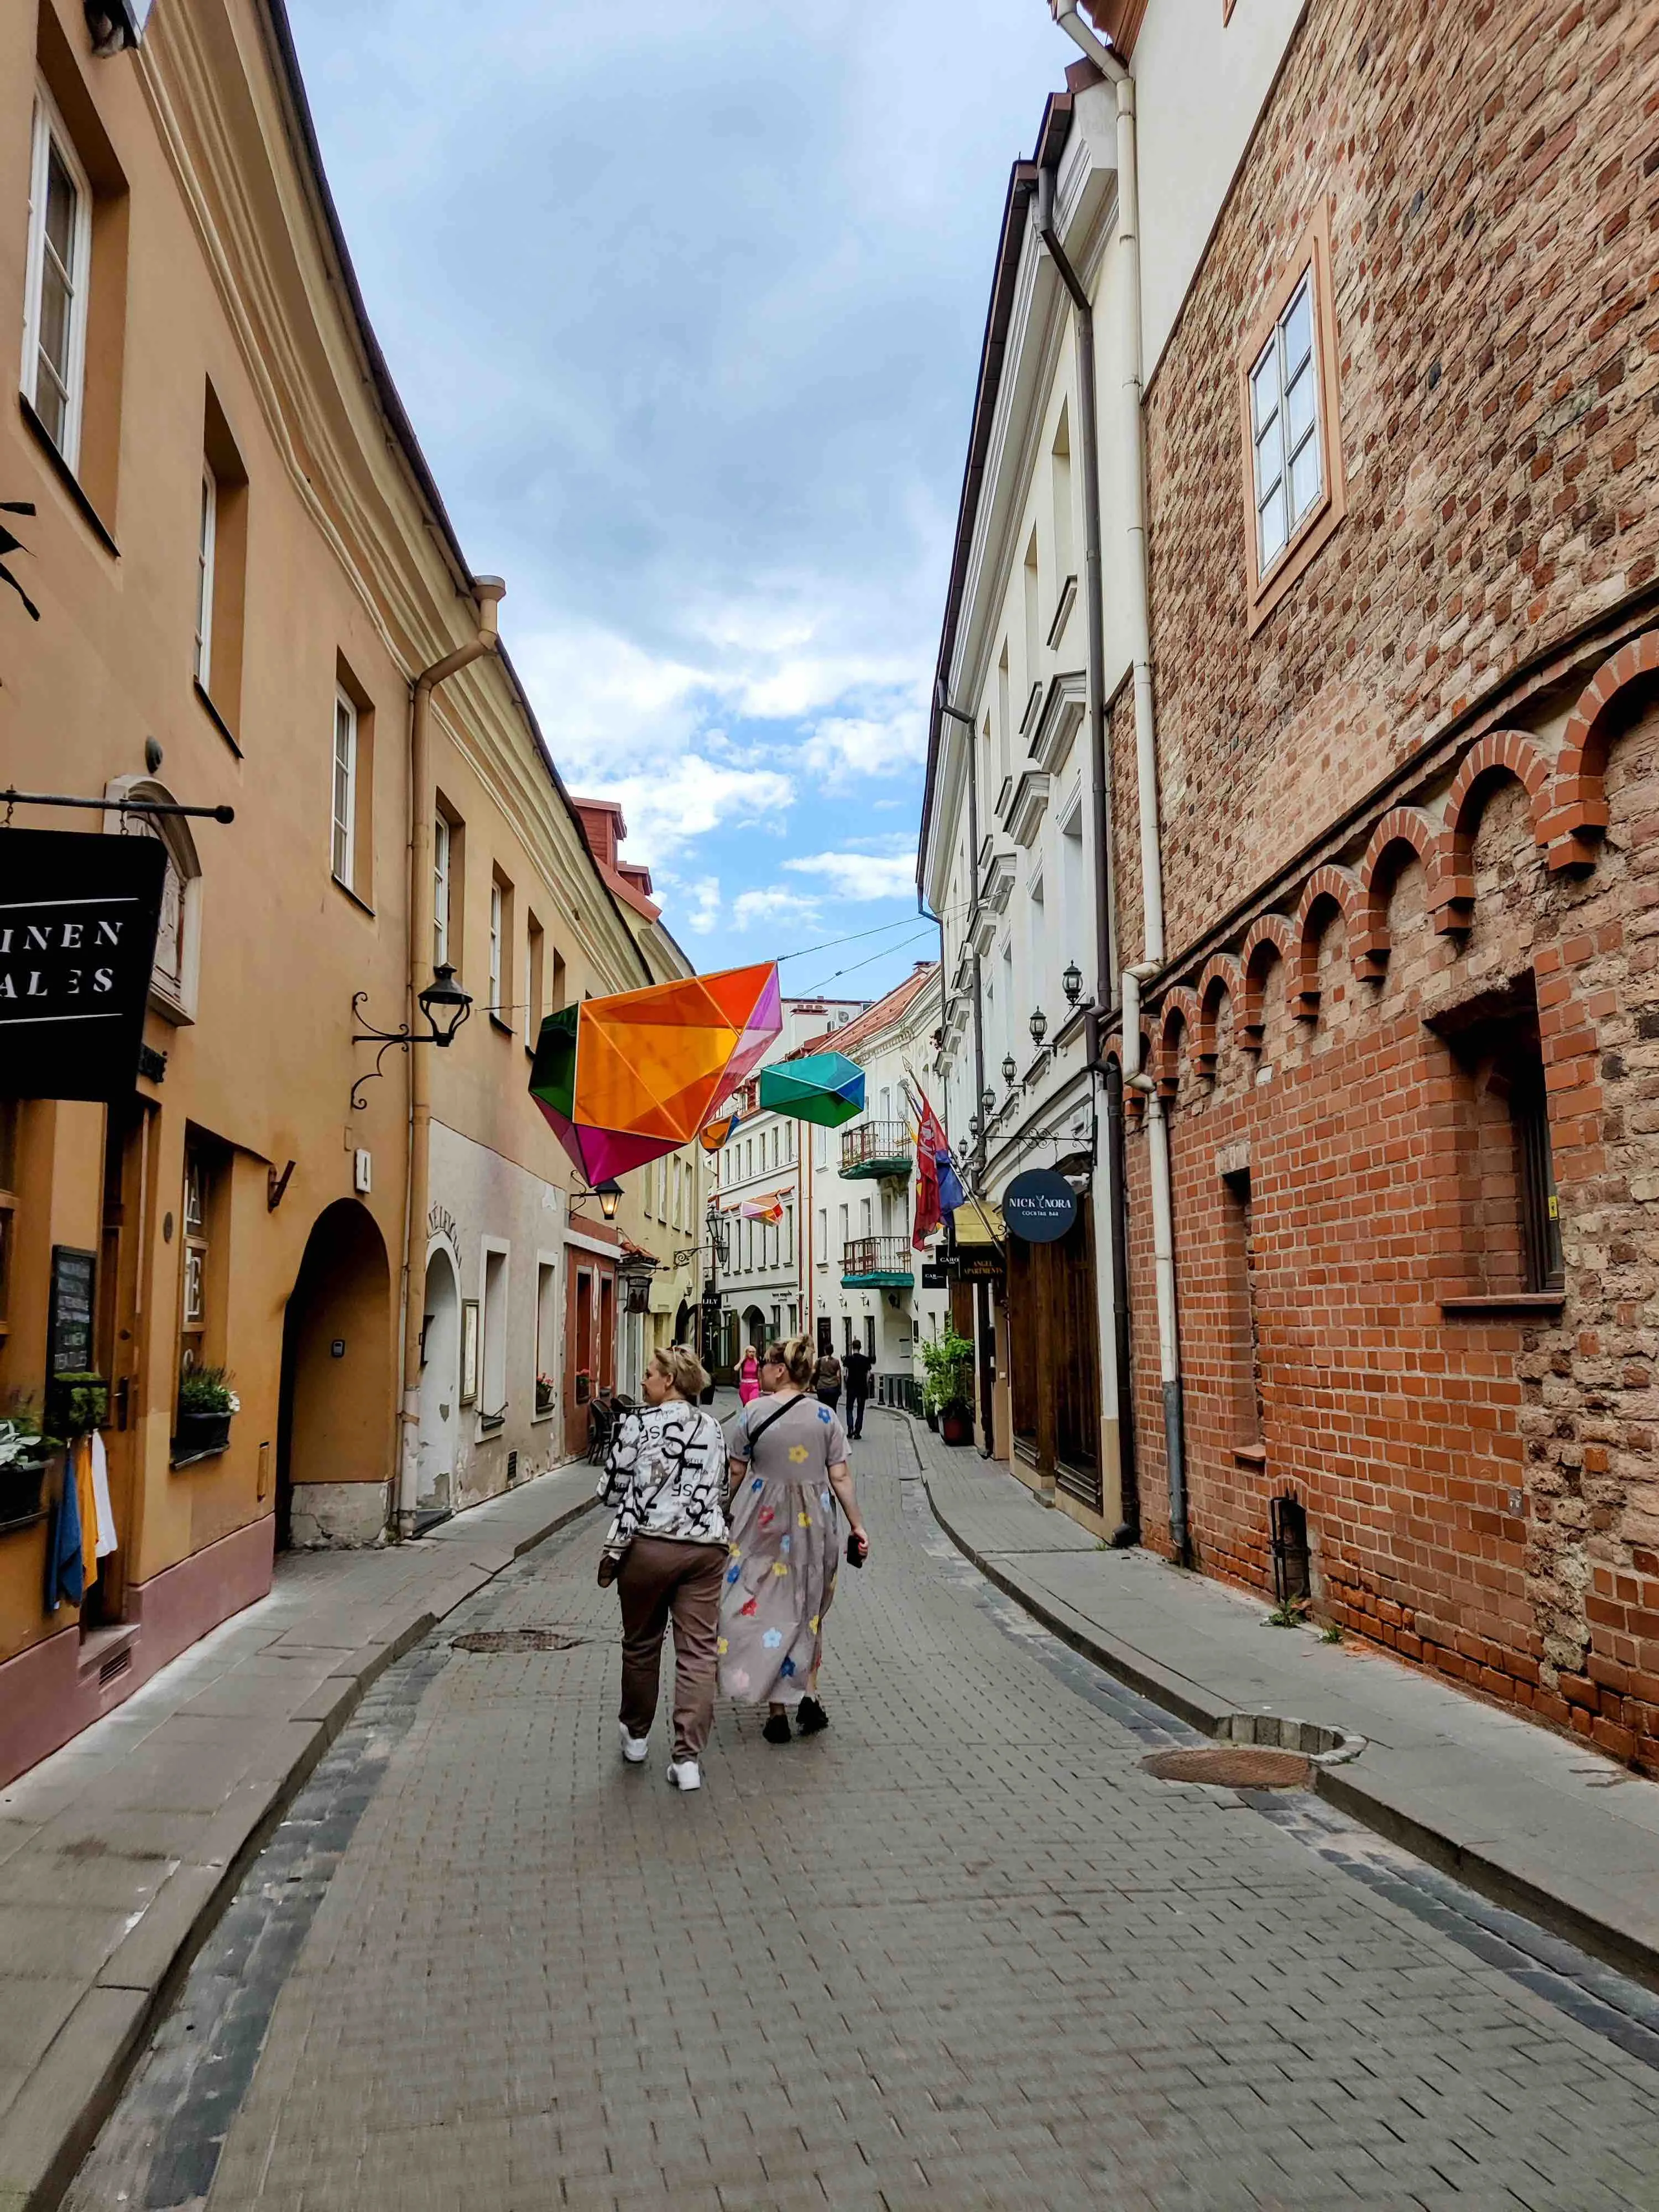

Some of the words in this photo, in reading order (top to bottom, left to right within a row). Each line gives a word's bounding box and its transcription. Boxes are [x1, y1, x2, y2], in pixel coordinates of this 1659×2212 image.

[0, 921, 123, 952] INEN
[1009, 1198, 1036, 1208] NICK
[1044, 1198, 1071, 1208] NORA
